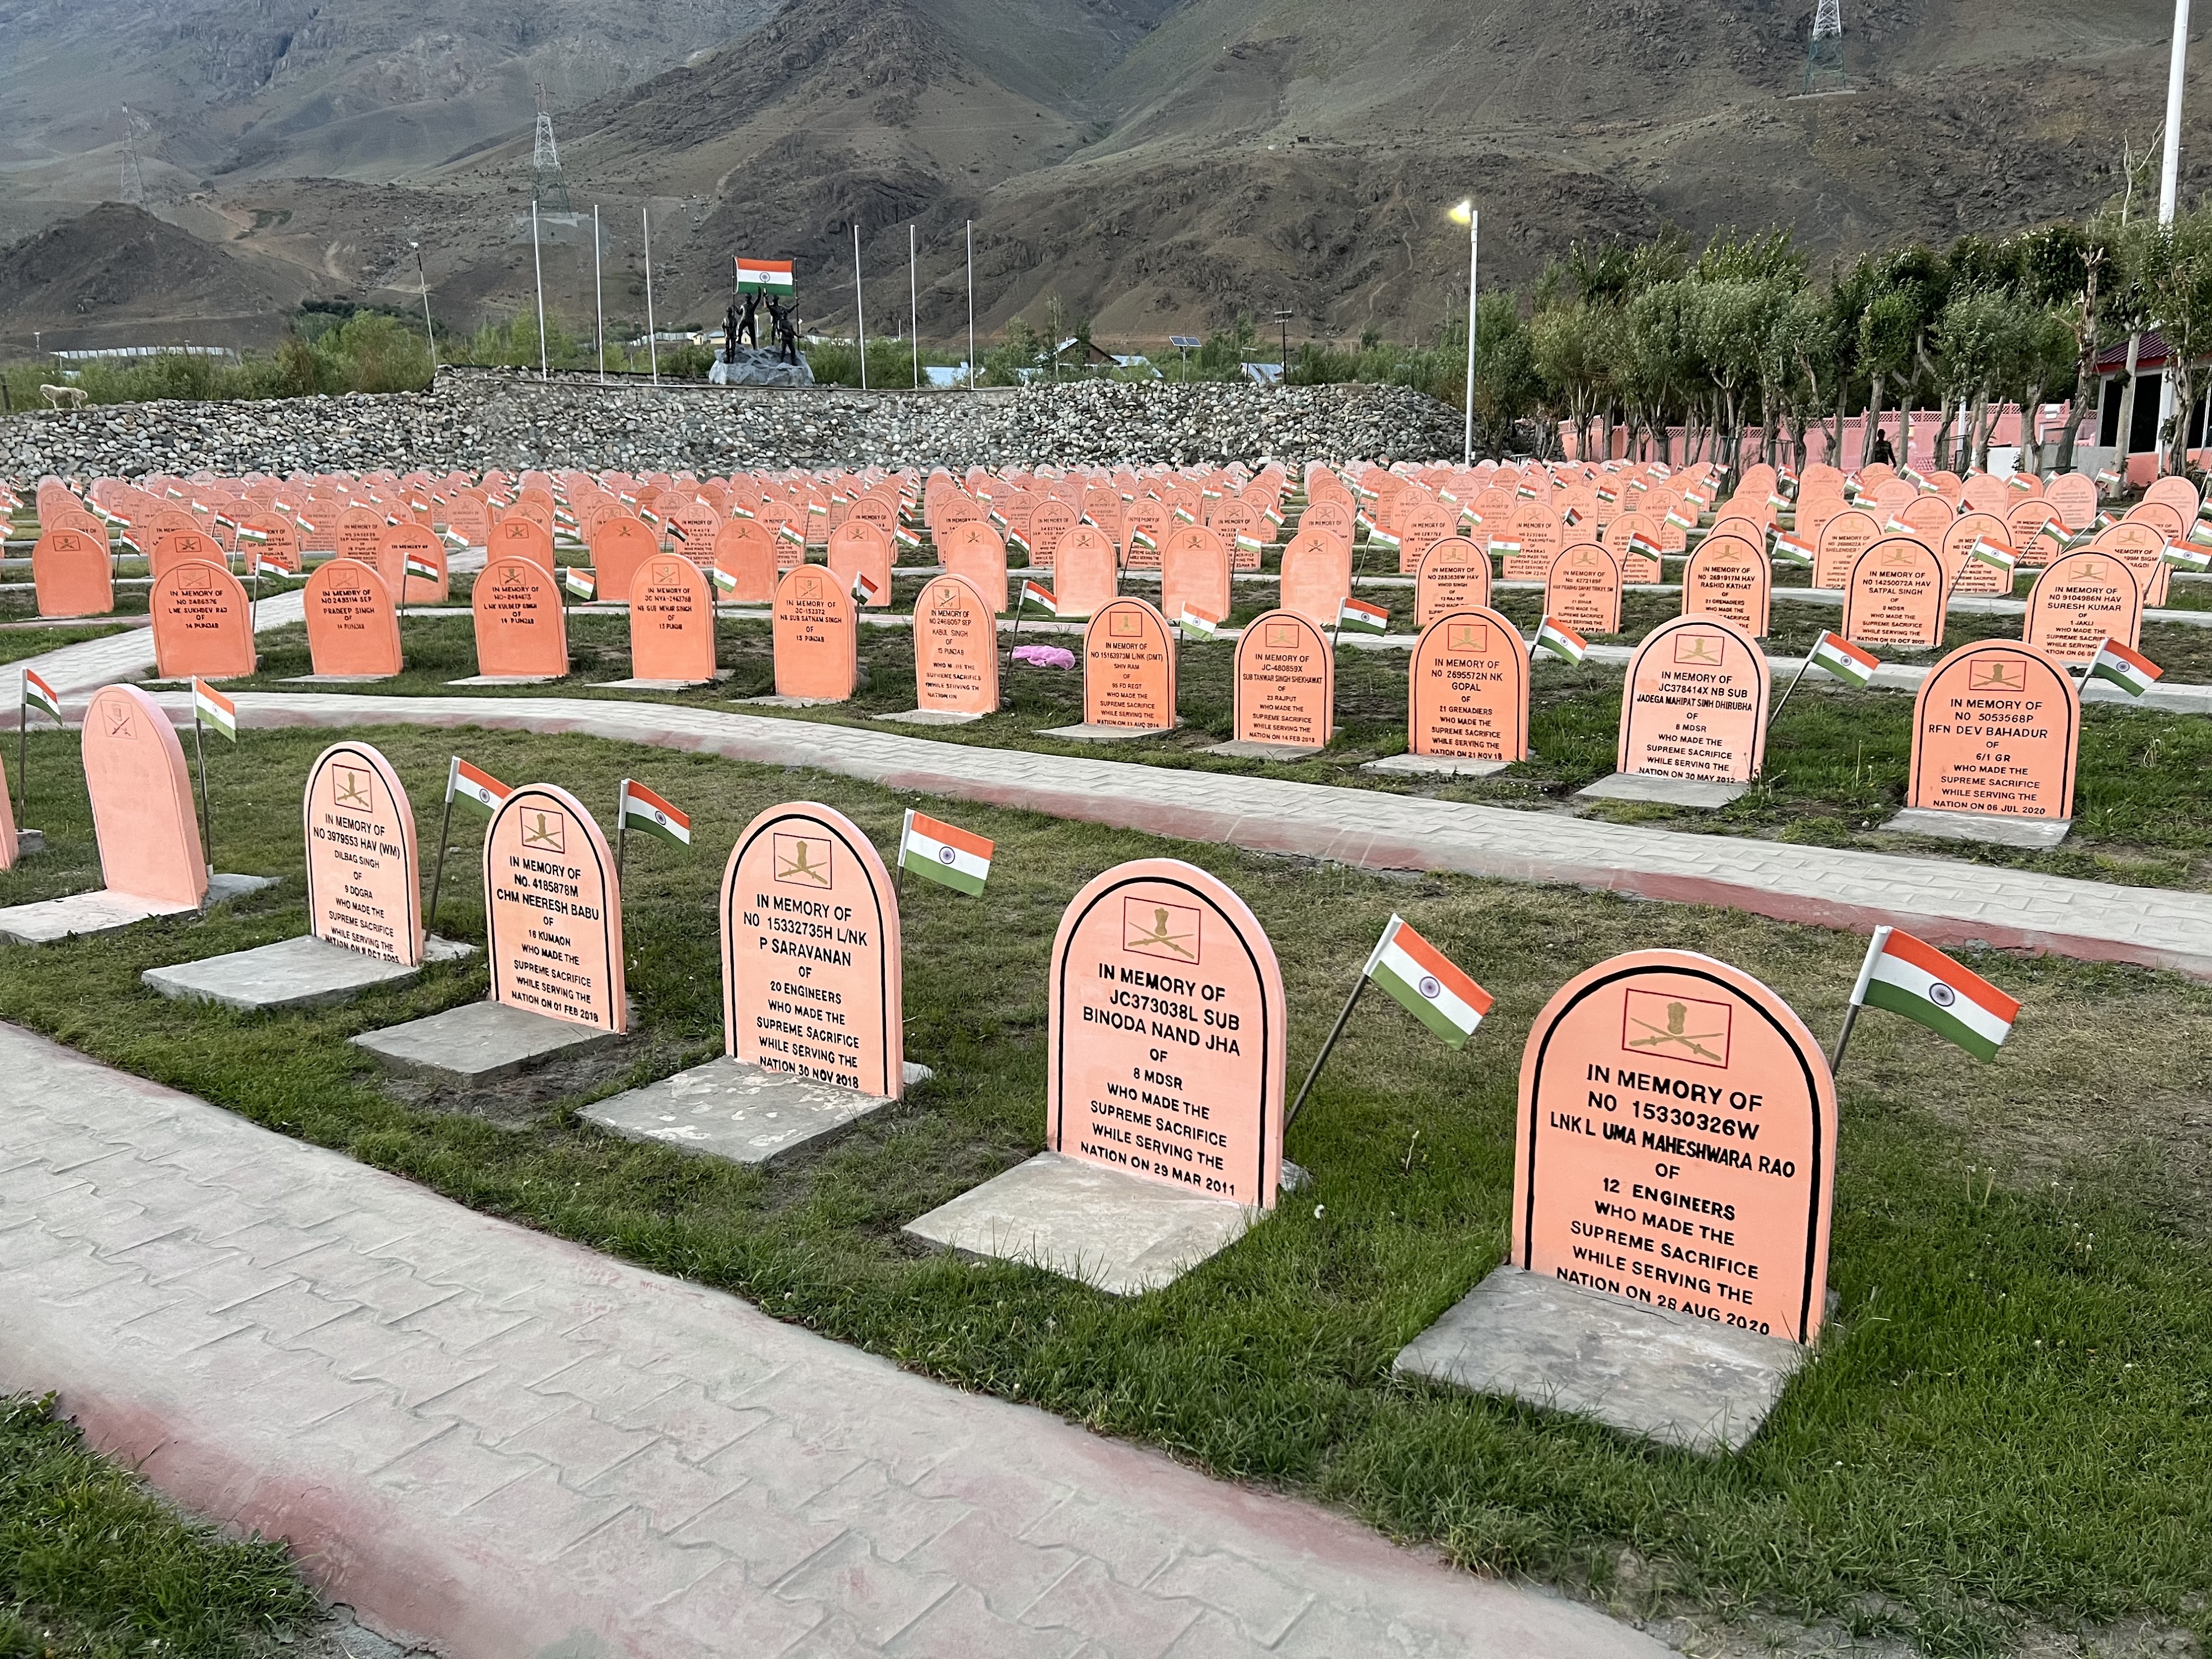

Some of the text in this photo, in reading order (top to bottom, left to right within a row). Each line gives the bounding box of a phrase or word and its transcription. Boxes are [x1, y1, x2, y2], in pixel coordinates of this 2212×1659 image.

[1447, 670, 1487, 680] 2695572N
[1490, 672, 1503, 681] NK
[1451, 681, 1481, 691] GOPAL
[1661, 671, 1733, 685] IN MEMORY OF
[1658, 683, 1747, 698] JC378414X NB SUB
[1448, 706, 1493, 715] GRENADIERS
[1715, 700, 1752, 711] DHIRUBHA
[1950, 698, 2042, 710] IN MEMORY OF
[1682, 724, 1707, 732] MDSR
[1978, 713, 2033, 723] 5053568P
[1928, 724, 2048, 738] RFN DEV BAHADUR
[1995, 754, 2010, 762] GR
[327, 830, 358, 847] 3979553
[360, 837, 377, 851] HAV
[379, 842, 400, 860] (WM)
[334, 849, 379, 869] DILBAG SINGH
[509, 855, 581, 880] IN MEMORY OF
[345, 884, 373, 899] 9 DOGRA
[532, 878, 578, 898] 4185878M
[497, 888, 599, 920] CHM NEERESH BABU
[757, 894, 852, 921] IN MEMORY OF
[543, 916, 554, 926] OF
[767, 916, 832, 940] 15332735H
[538, 931, 571, 947] KUMAON
[759, 936, 851, 967] P SARAVANAN
[798, 966, 812, 978] OF
[1099, 963, 1225, 1002] IN MEMORY OF
[770, 980, 841, 1004] 20 ENGINEERS
[1110, 989, 1239, 1031] JC373038L SUB
[1083, 1006, 1240, 1056] BINODA NAND JHA
[1150, 1048, 1168, 1062] OF
[1133, 1067, 1183, 1091] 8 MDSR
[1586, 1063, 1763, 1112] IN MEMORY OF
[1632, 1100, 1760, 1140] 15330326W
[1603, 1122, 1636, 1145] UMA
[1641, 1130, 1752, 1171] MAHESHWARA
[1758, 1155, 1795, 1178] RAO
[1655, 1162, 1680, 1179] OF
[1603, 1177, 1735, 1221] 12 ENGINEERS
[1594, 1200, 1735, 1246] WHO MADE THE
[1570, 1220, 1758, 1279] SUPREME SACRIFICE
[1572, 1245, 1753, 1305] WHILE SERVING THE
[1557, 1266, 1770, 1335] NATION ON 28 AUG 2020
